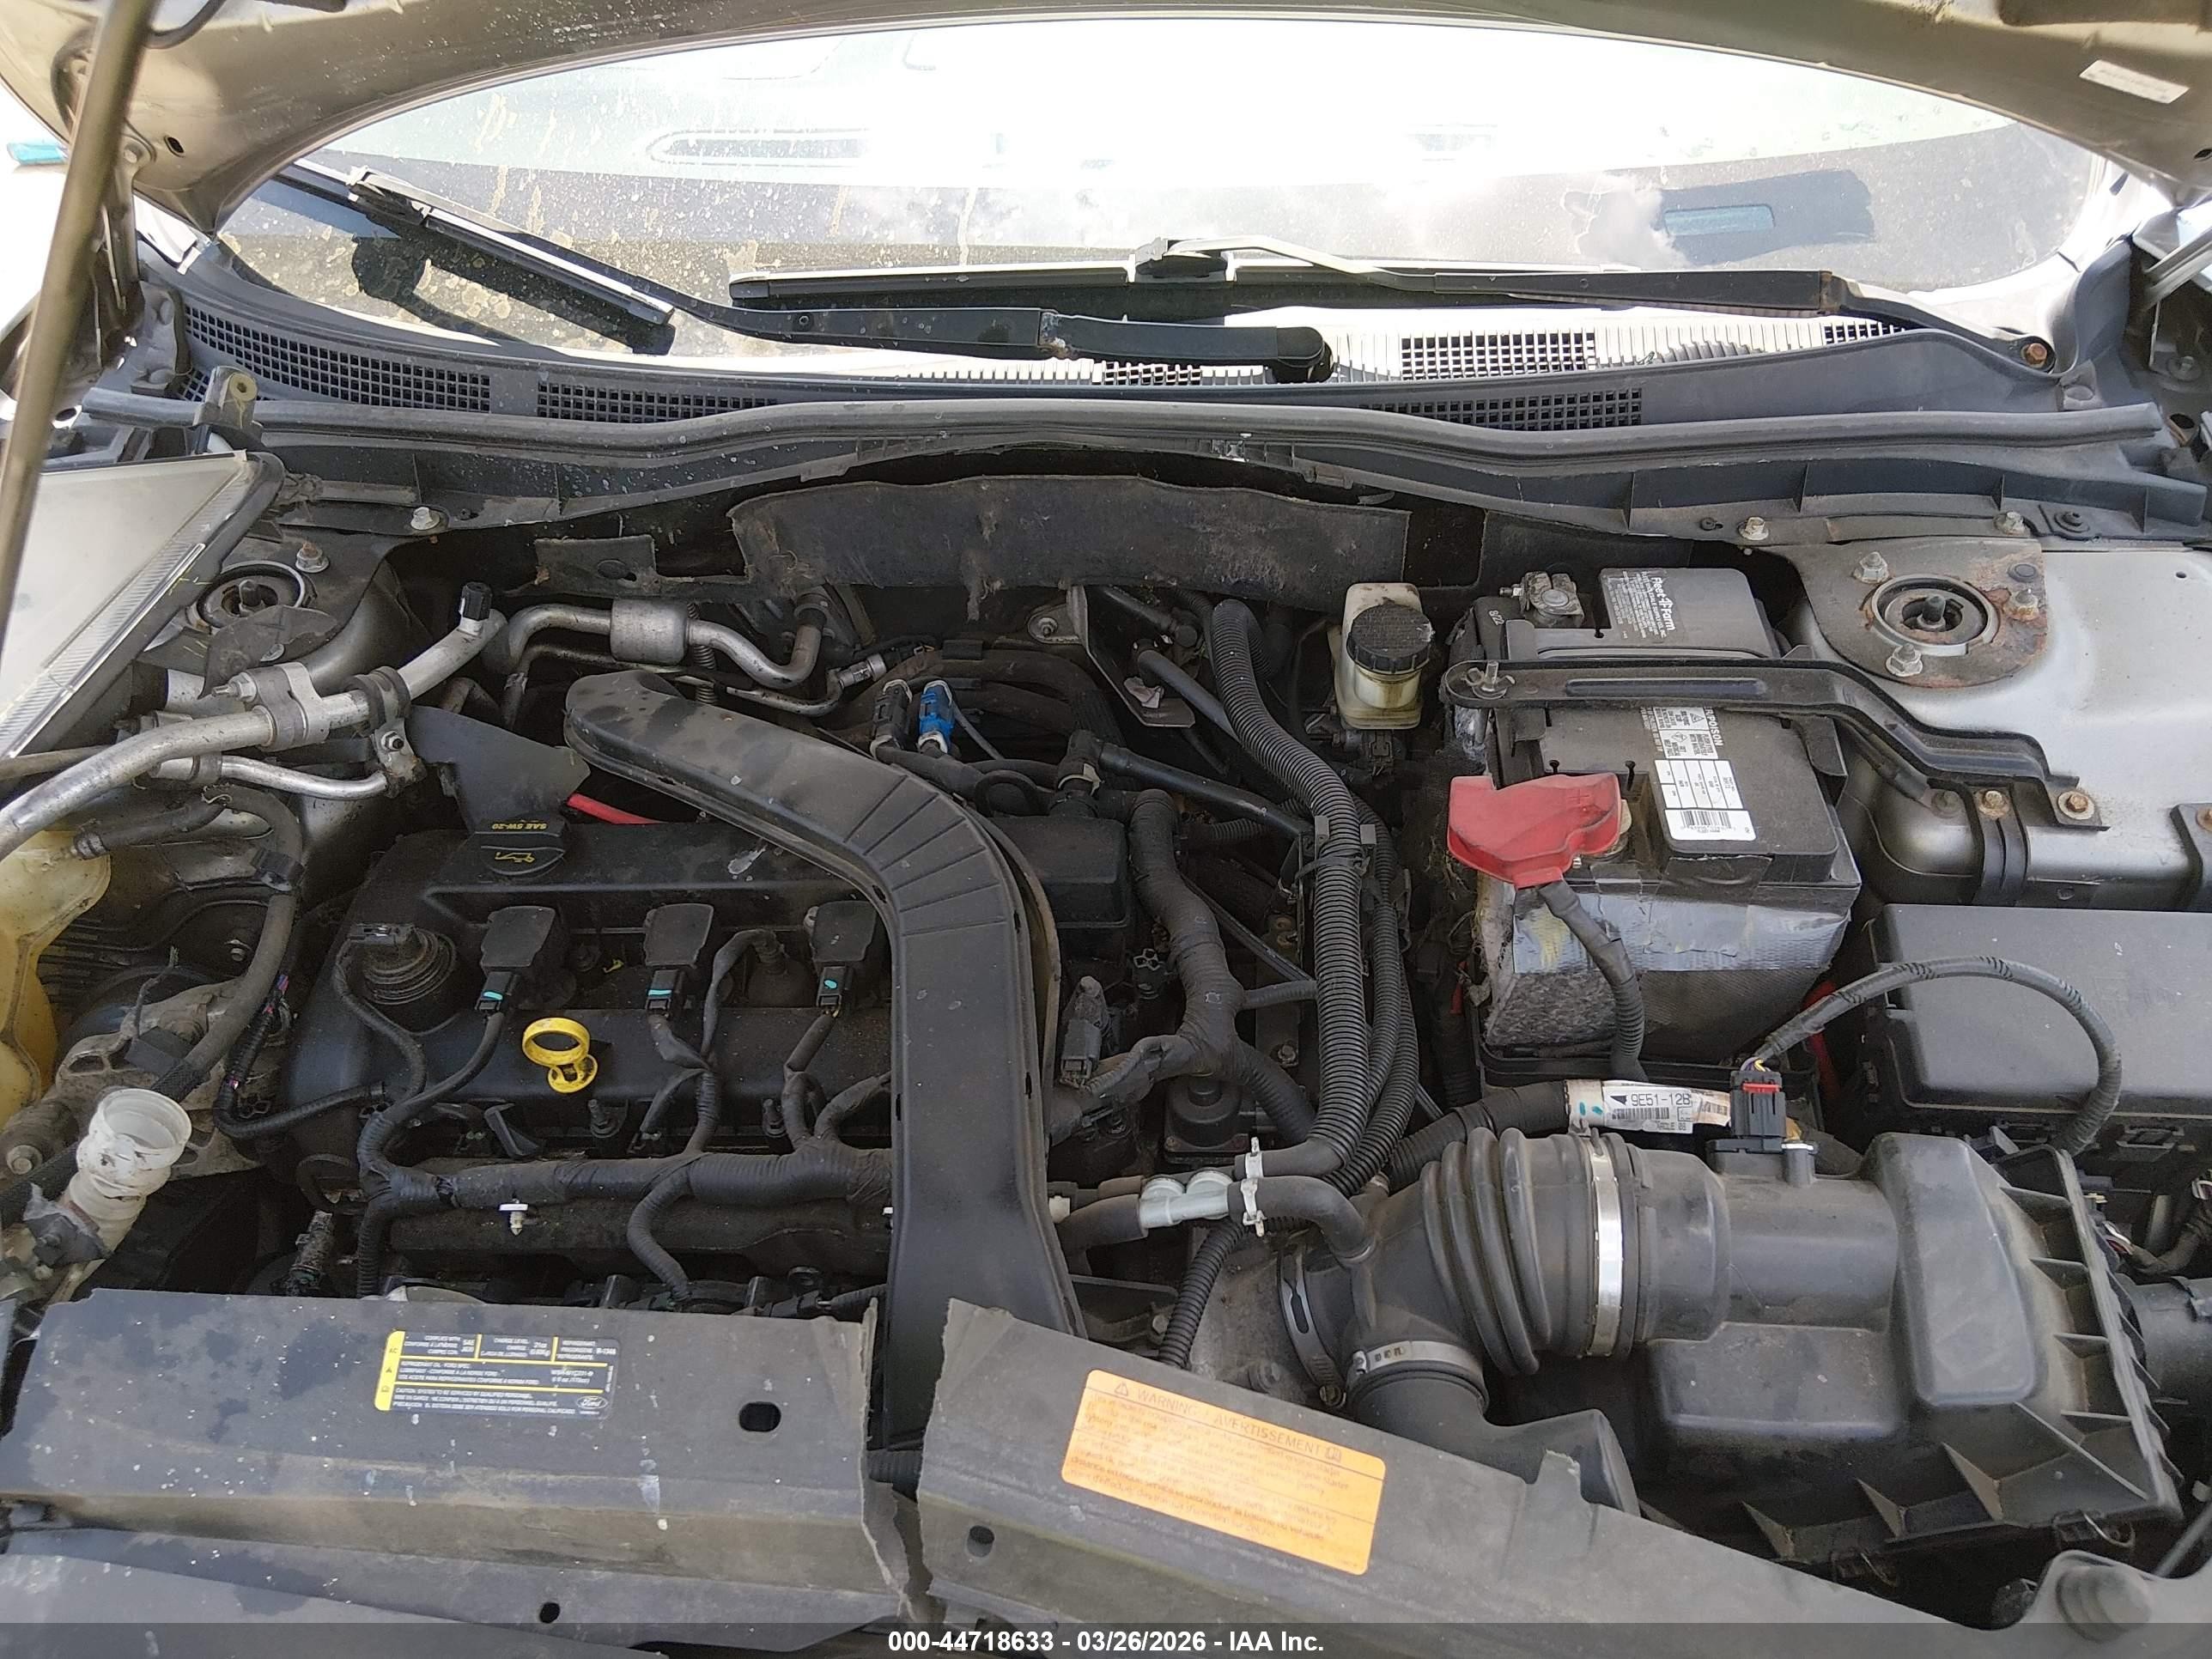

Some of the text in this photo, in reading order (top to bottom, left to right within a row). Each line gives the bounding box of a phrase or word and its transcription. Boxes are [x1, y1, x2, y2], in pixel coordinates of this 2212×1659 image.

[1488, 610, 1505, 626] 8/22
[1650, 576, 1676, 630] Fleet Farm
[580, 1398, 603, 1407] Ford
[1137, 1388, 1199, 1416] WARNING
[1212, 1413, 1322, 1455] AVERTISSEMENT
